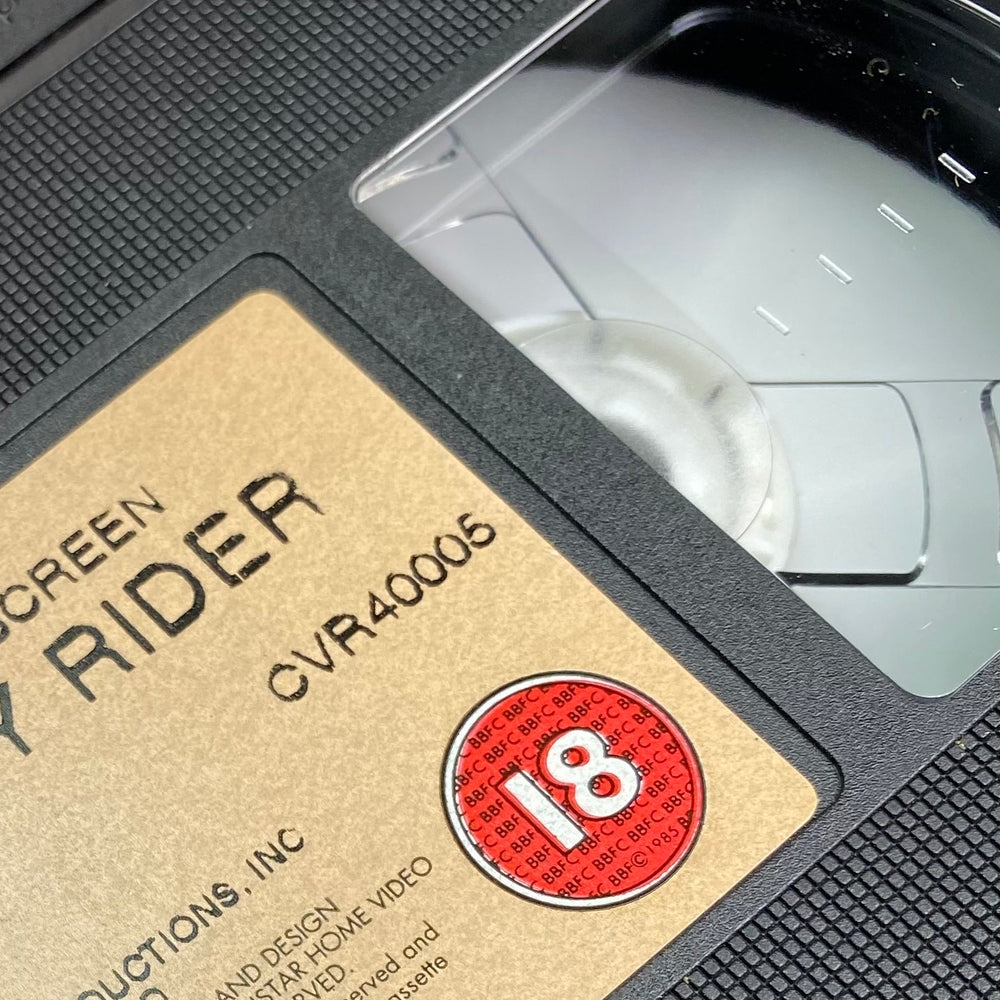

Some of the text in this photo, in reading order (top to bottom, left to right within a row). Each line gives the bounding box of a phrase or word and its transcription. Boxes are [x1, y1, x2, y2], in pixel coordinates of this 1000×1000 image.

[43, 470, 325, 702] RIDER
[266, 512, 498, 704] CVR40005
[499, 727, 642, 854] 18
[245, 828, 304, 881] INC
[260, 897, 341, 967] DESIGN
[304, 906, 373, 966] HOME
[366, 856, 433, 910] VIDEO
[402, 920, 440, 960] and
